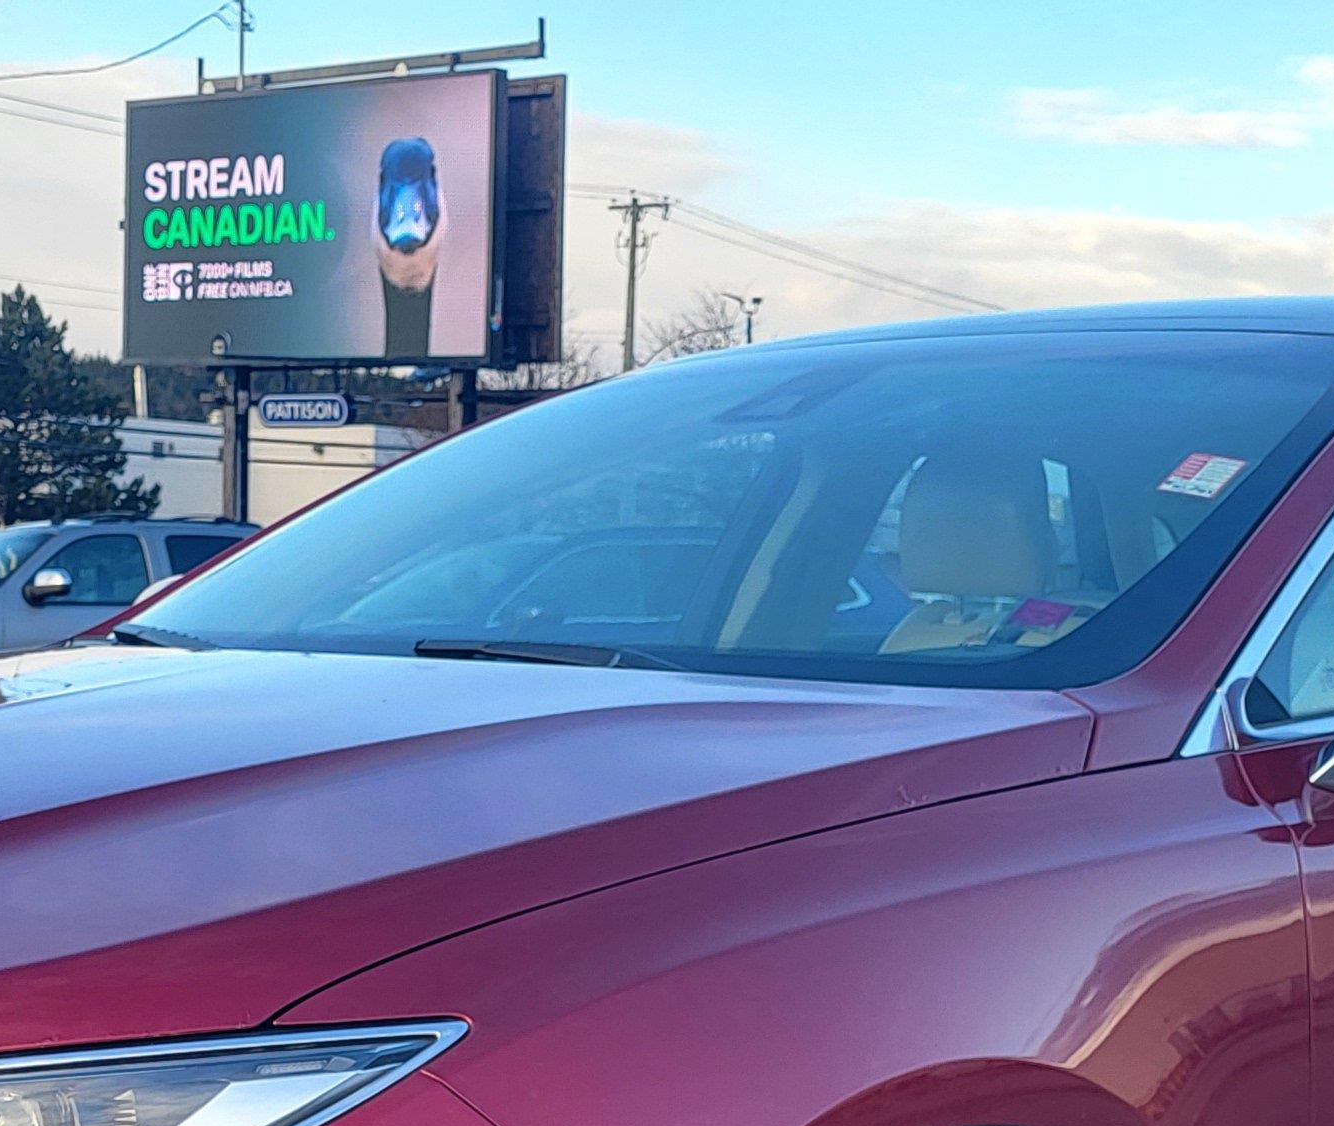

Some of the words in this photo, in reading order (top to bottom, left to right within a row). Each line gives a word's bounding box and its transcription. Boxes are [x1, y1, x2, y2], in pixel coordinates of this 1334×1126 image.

[144, 154, 285, 202] STREAM
[143, 200, 335, 248] CANADIAN.
[234, 261, 273, 278] FILMS
[197, 282, 228, 299] FREE
[266, 401, 341, 420] PATTISON
